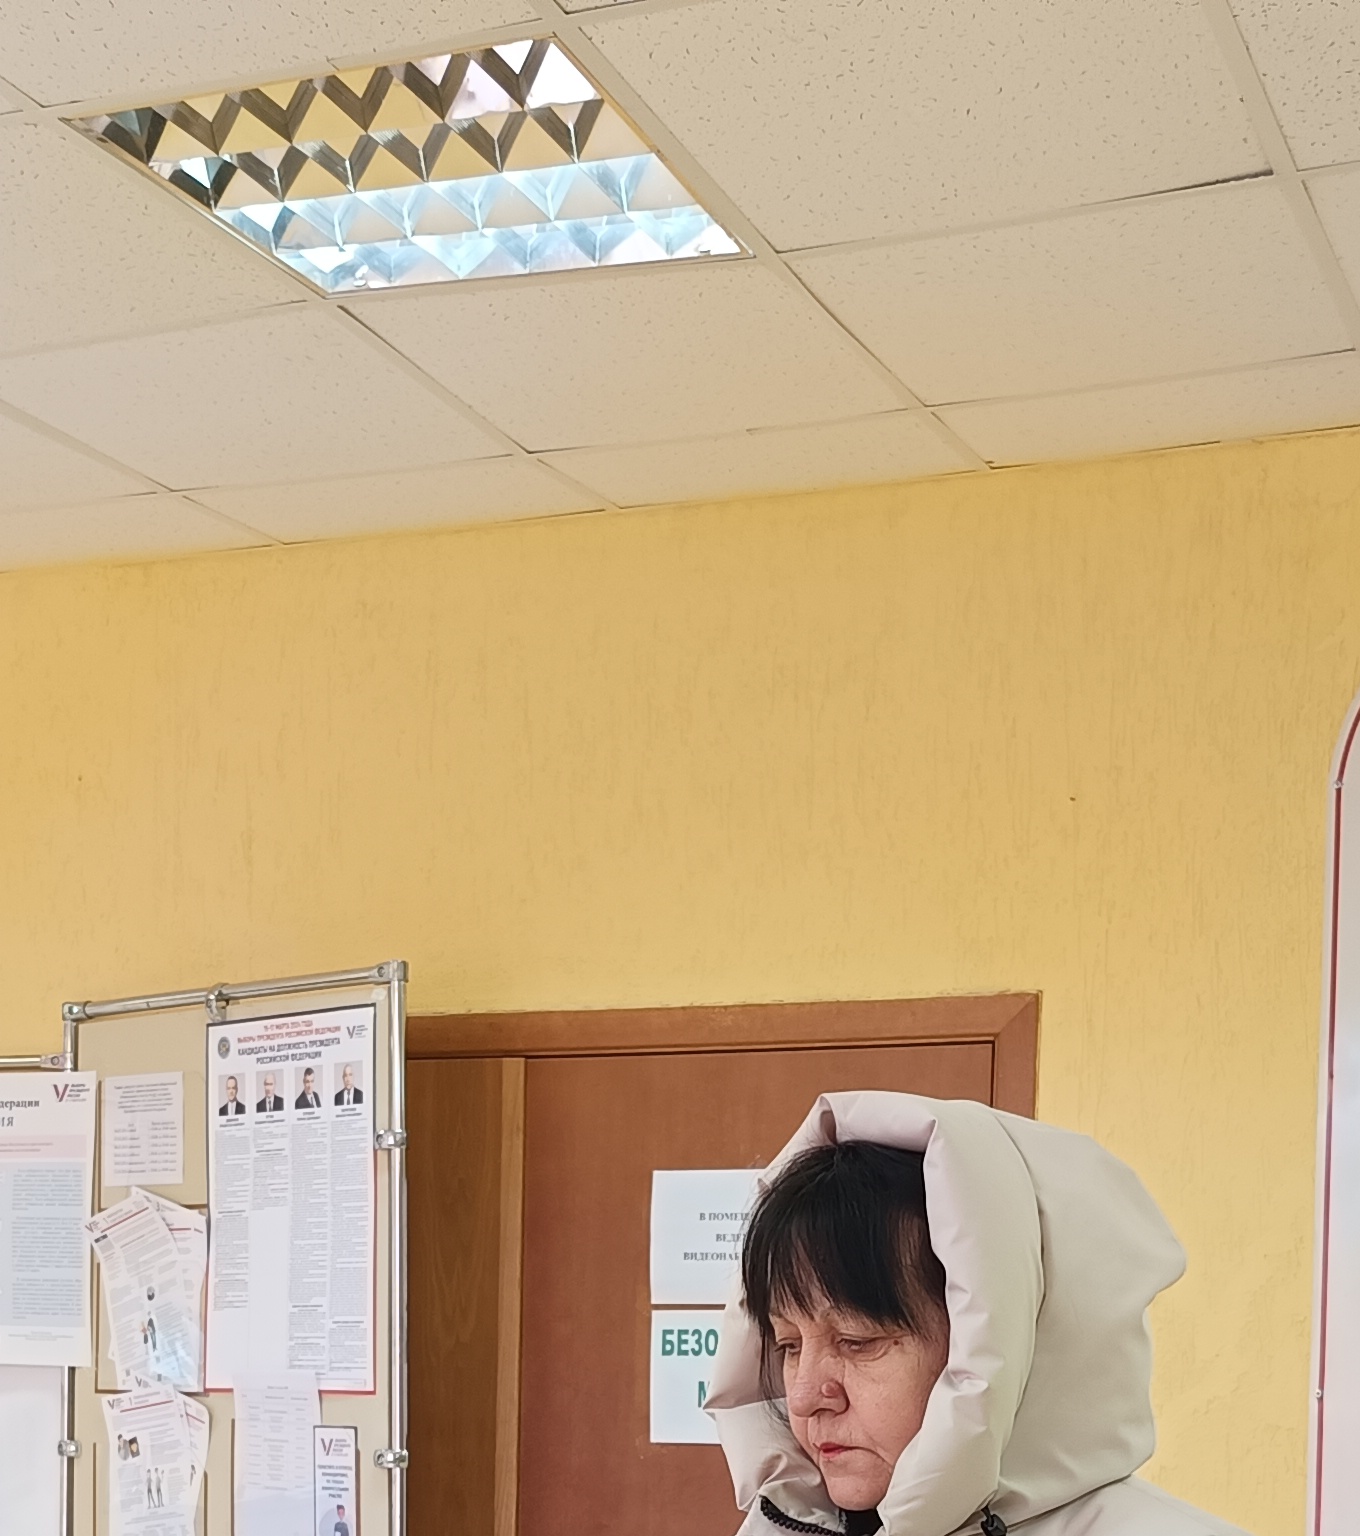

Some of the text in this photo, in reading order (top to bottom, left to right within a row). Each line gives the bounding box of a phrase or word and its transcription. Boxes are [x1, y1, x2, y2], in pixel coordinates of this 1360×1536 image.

[709, 1212, 750, 1221] ПОМЕЩ
[716, 1234, 746, 1242] ВЕДЕ
[661, 1329, 718, 1356] БЕЗО
